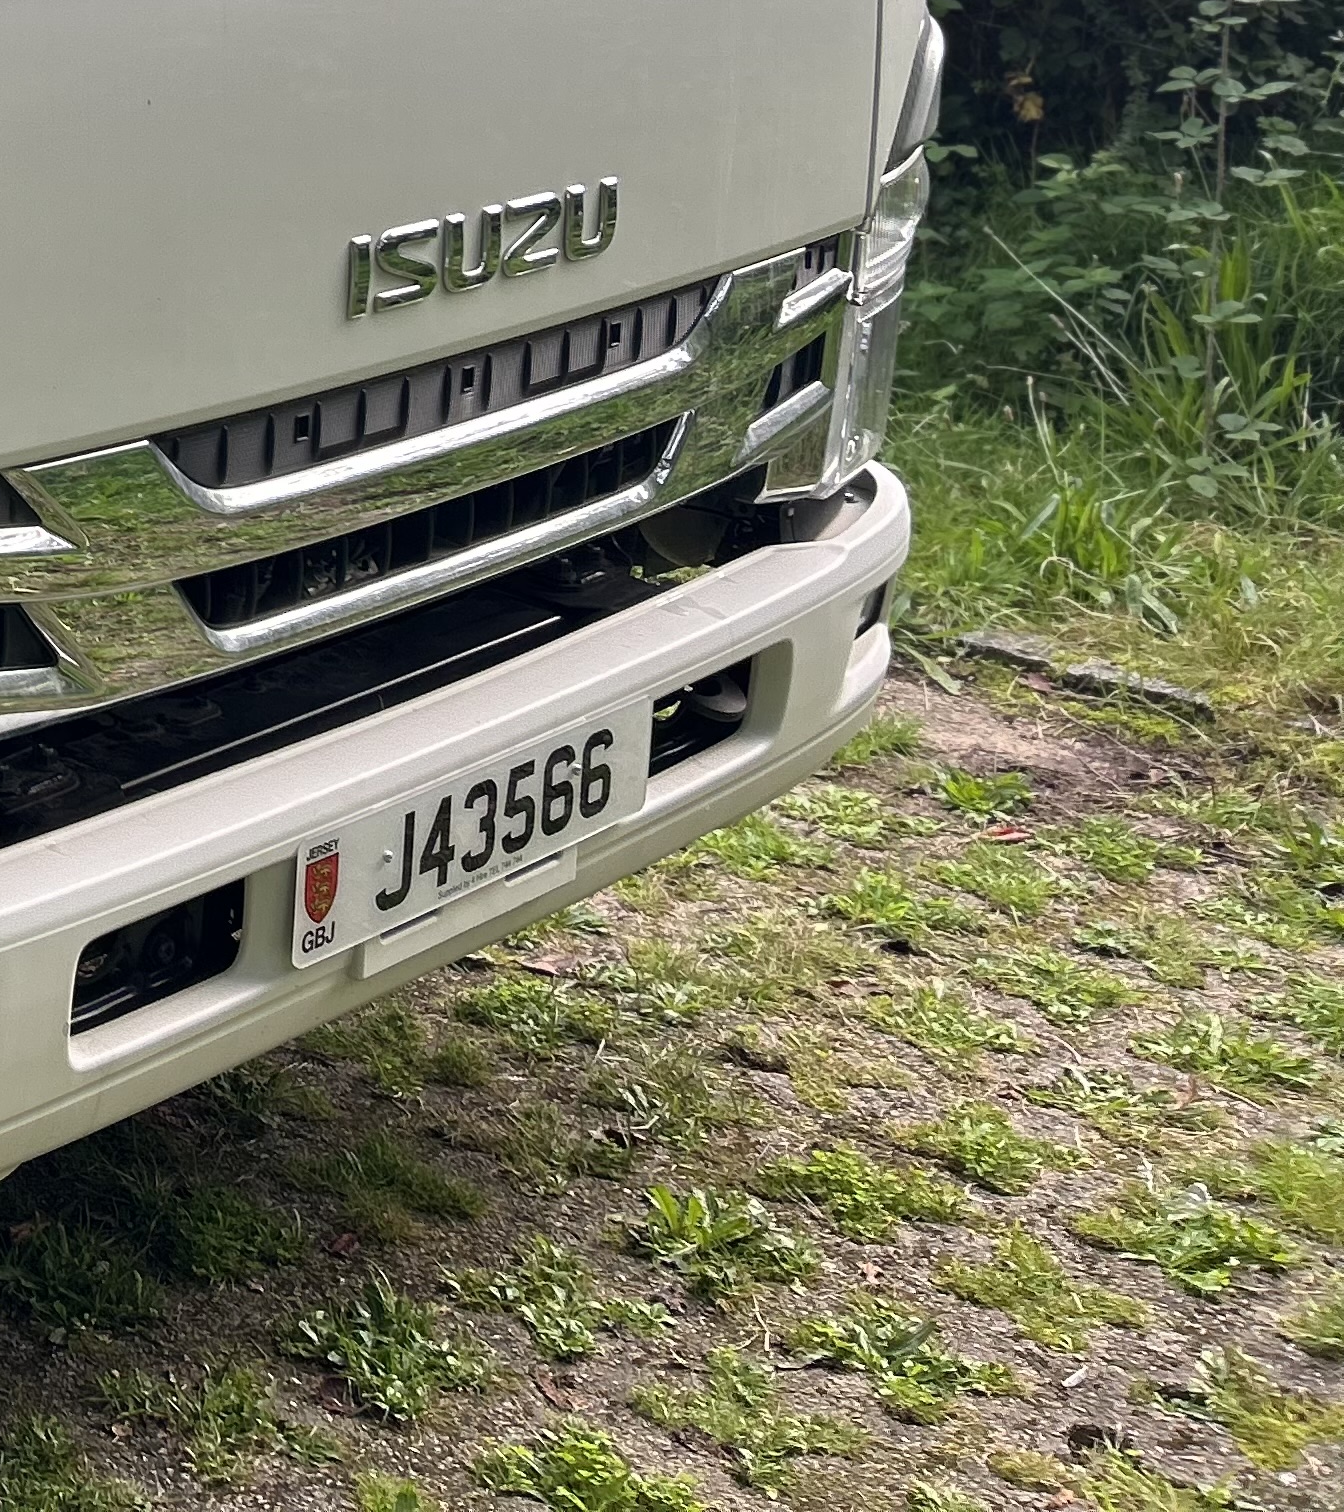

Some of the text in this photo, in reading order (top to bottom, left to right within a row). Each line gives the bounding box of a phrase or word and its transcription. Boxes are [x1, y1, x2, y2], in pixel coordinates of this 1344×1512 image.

[347, 175, 619, 319] ISUZU
[306, 838, 340, 862] JERSEY
[375, 728, 613, 911] J43566
[302, 921, 336, 954] GBJ
